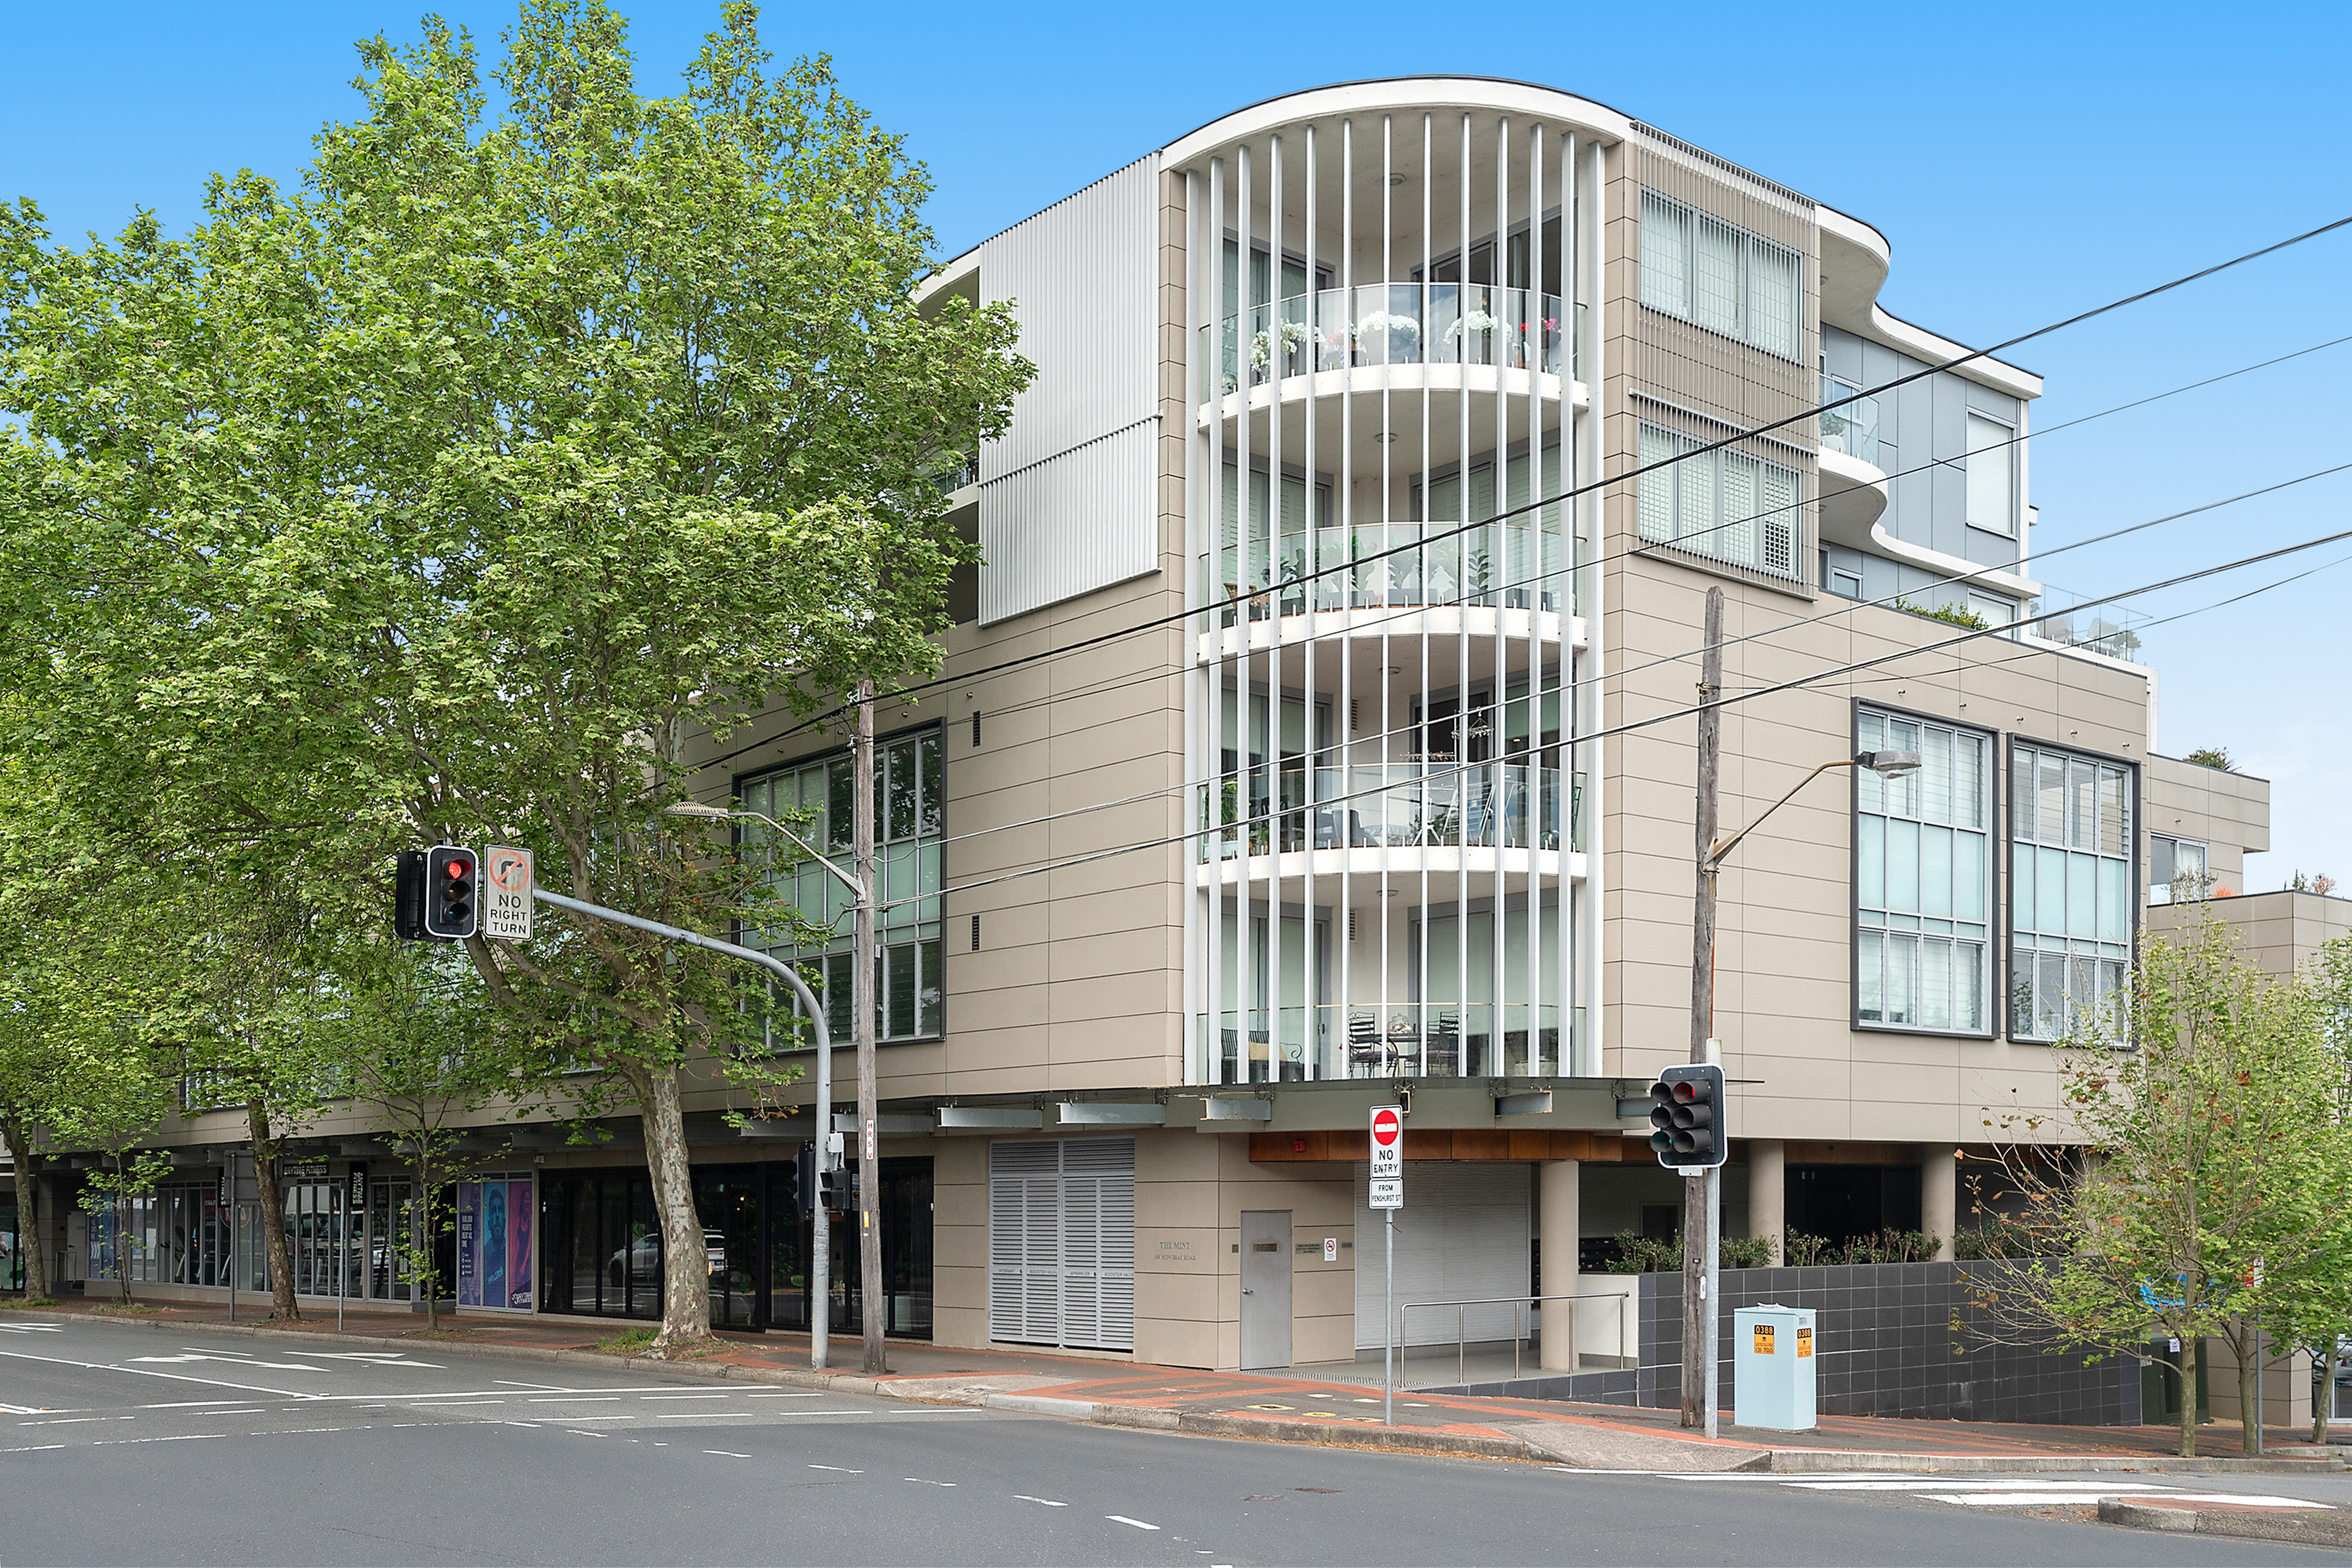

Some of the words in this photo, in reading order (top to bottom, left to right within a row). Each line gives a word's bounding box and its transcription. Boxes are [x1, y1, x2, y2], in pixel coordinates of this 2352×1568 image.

[499, 894, 521, 908] NO
[490, 909, 527, 921] RIGHT
[493, 922, 526, 934] TURN
[1379, 1150, 1393, 1160] NO
[1374, 1163, 1398, 1173] ENTRY
[1756, 1326, 1773, 1334] 0388
[1798, 1328, 1811, 1338] 0388
